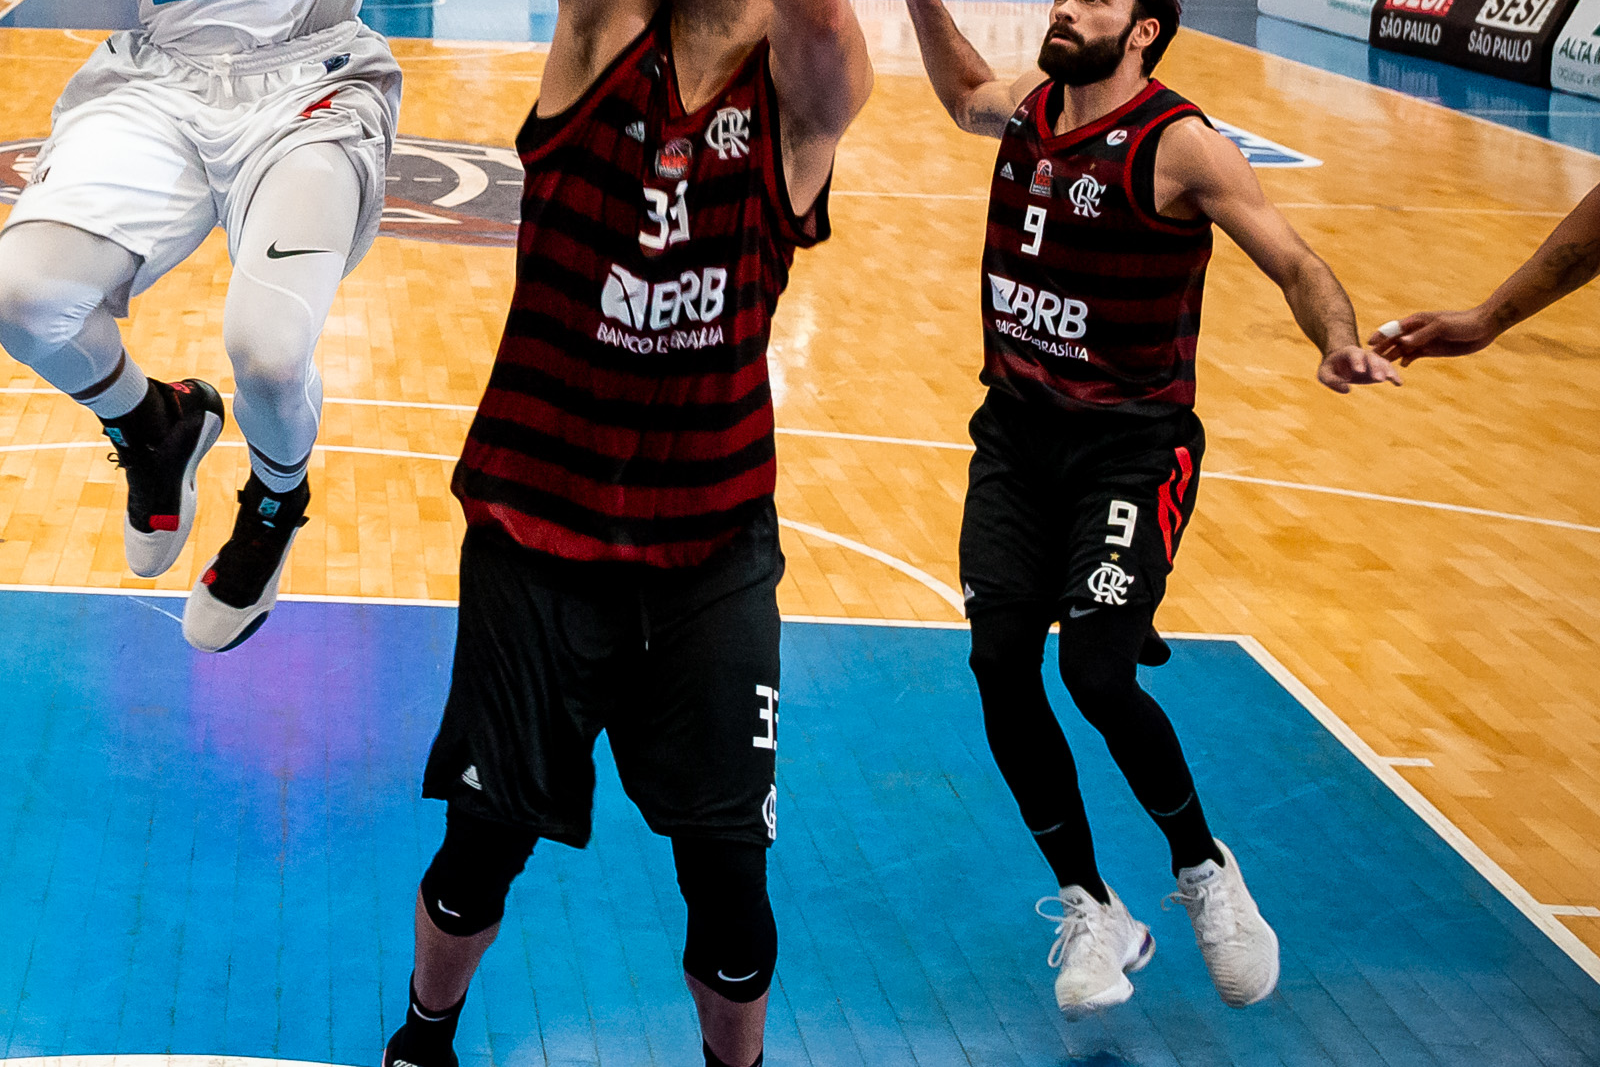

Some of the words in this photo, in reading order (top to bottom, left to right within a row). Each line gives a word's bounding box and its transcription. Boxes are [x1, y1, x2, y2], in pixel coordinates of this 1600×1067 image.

[1379, 14, 1402, 38] SÃO
[1403, 19, 1442, 46] PAULO
[1468, 26, 1492, 54] SÃO
[1492, 35, 1532, 63] PAULO
[1558, 35, 1592, 65] ALTA
[1020, 204, 1048, 257] 9
[1011, 283, 1089, 340] BRB
[596, 321, 654, 355] BANCO
[1104, 499, 1139, 548] 9
